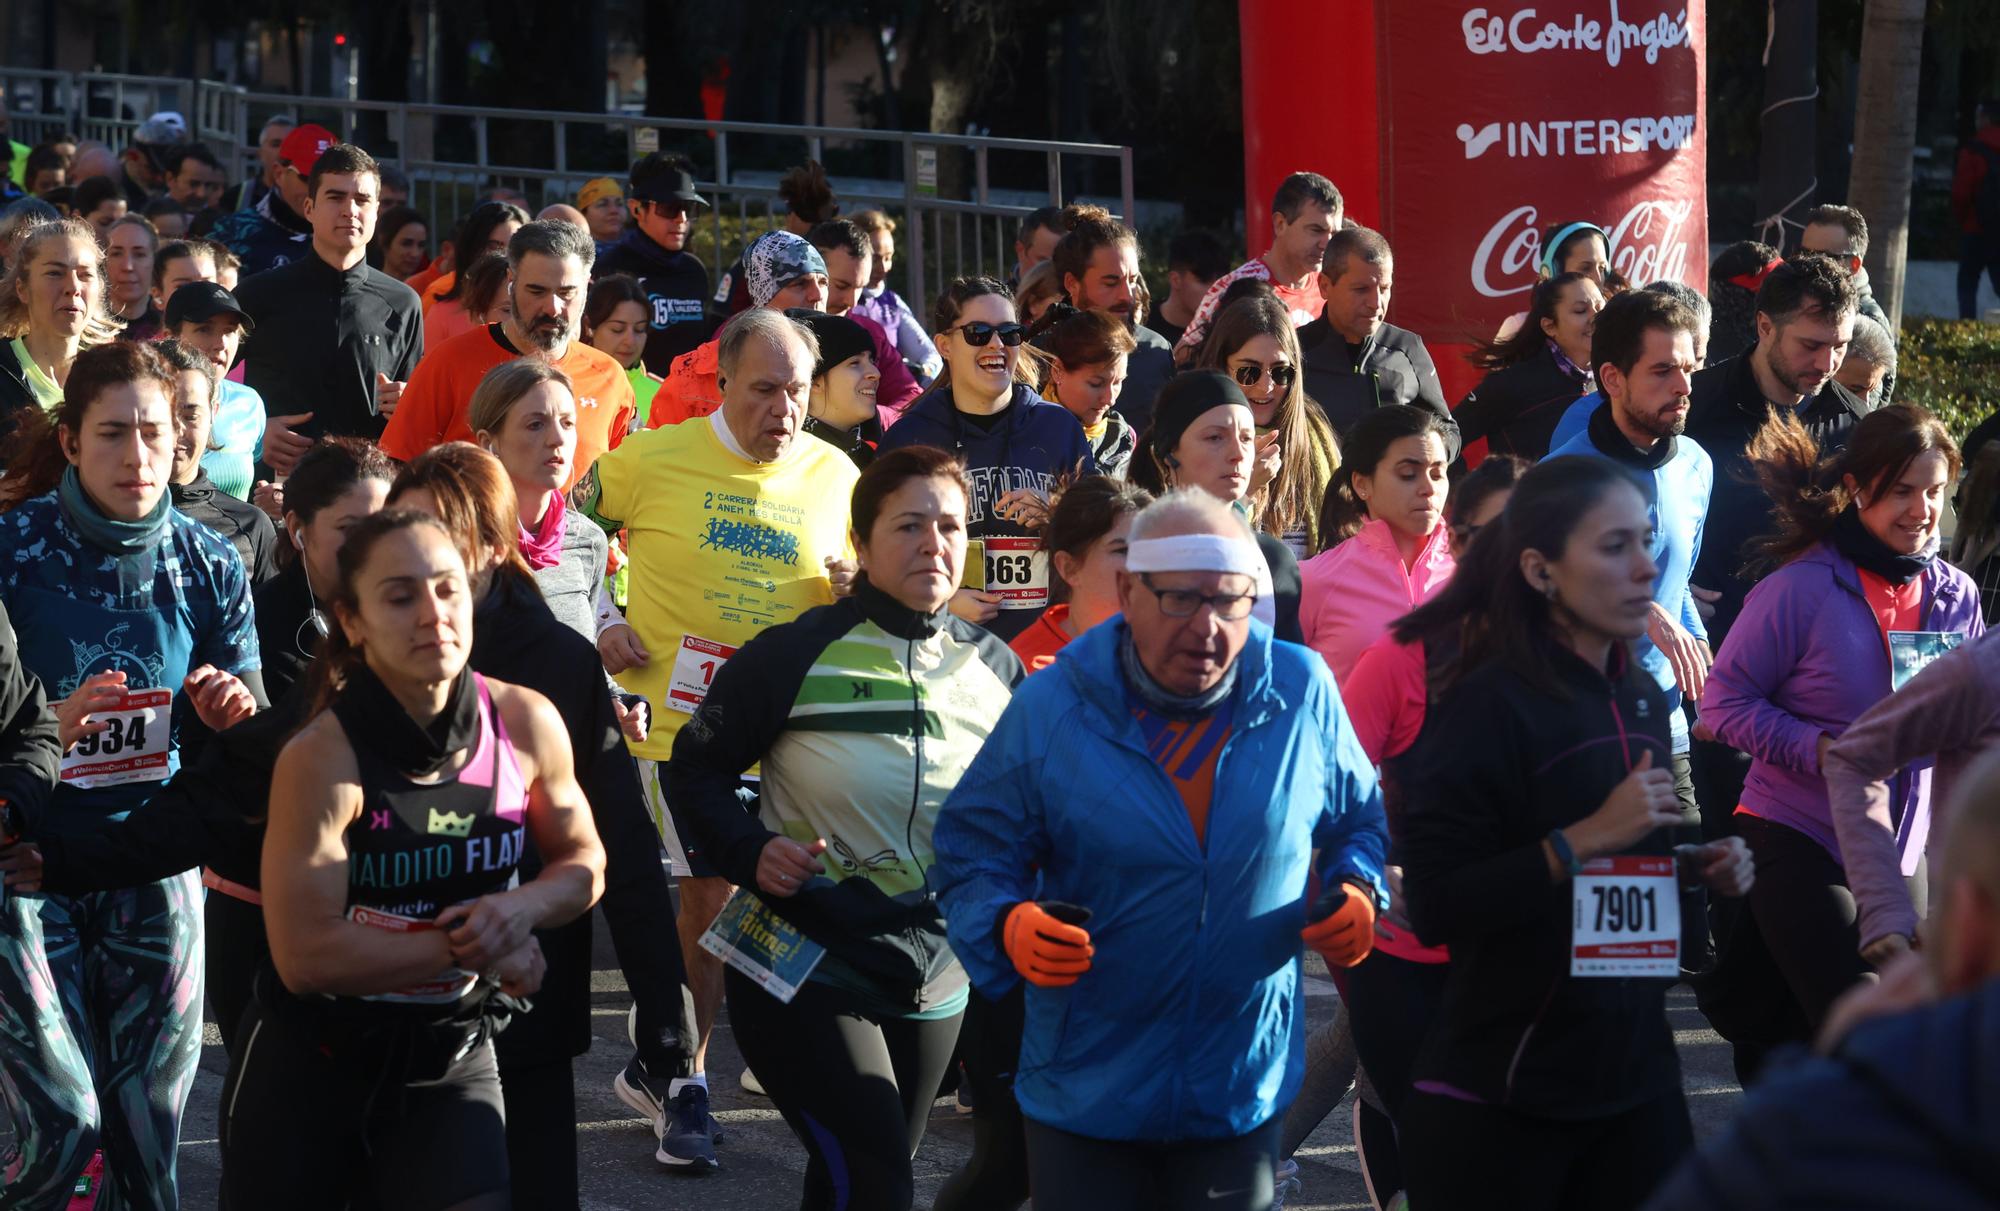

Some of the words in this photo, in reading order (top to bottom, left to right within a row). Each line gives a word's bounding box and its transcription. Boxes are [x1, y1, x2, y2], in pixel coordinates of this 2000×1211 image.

[1462, 8, 1507, 54] El
[1508, 8, 1601, 54] Corte
[1508, 115, 1694, 157] INTERSPORT
[717, 493, 758, 506] CARRERA
[717, 503, 744, 514] ANEM
[1592, 885, 1657, 932] 7901
